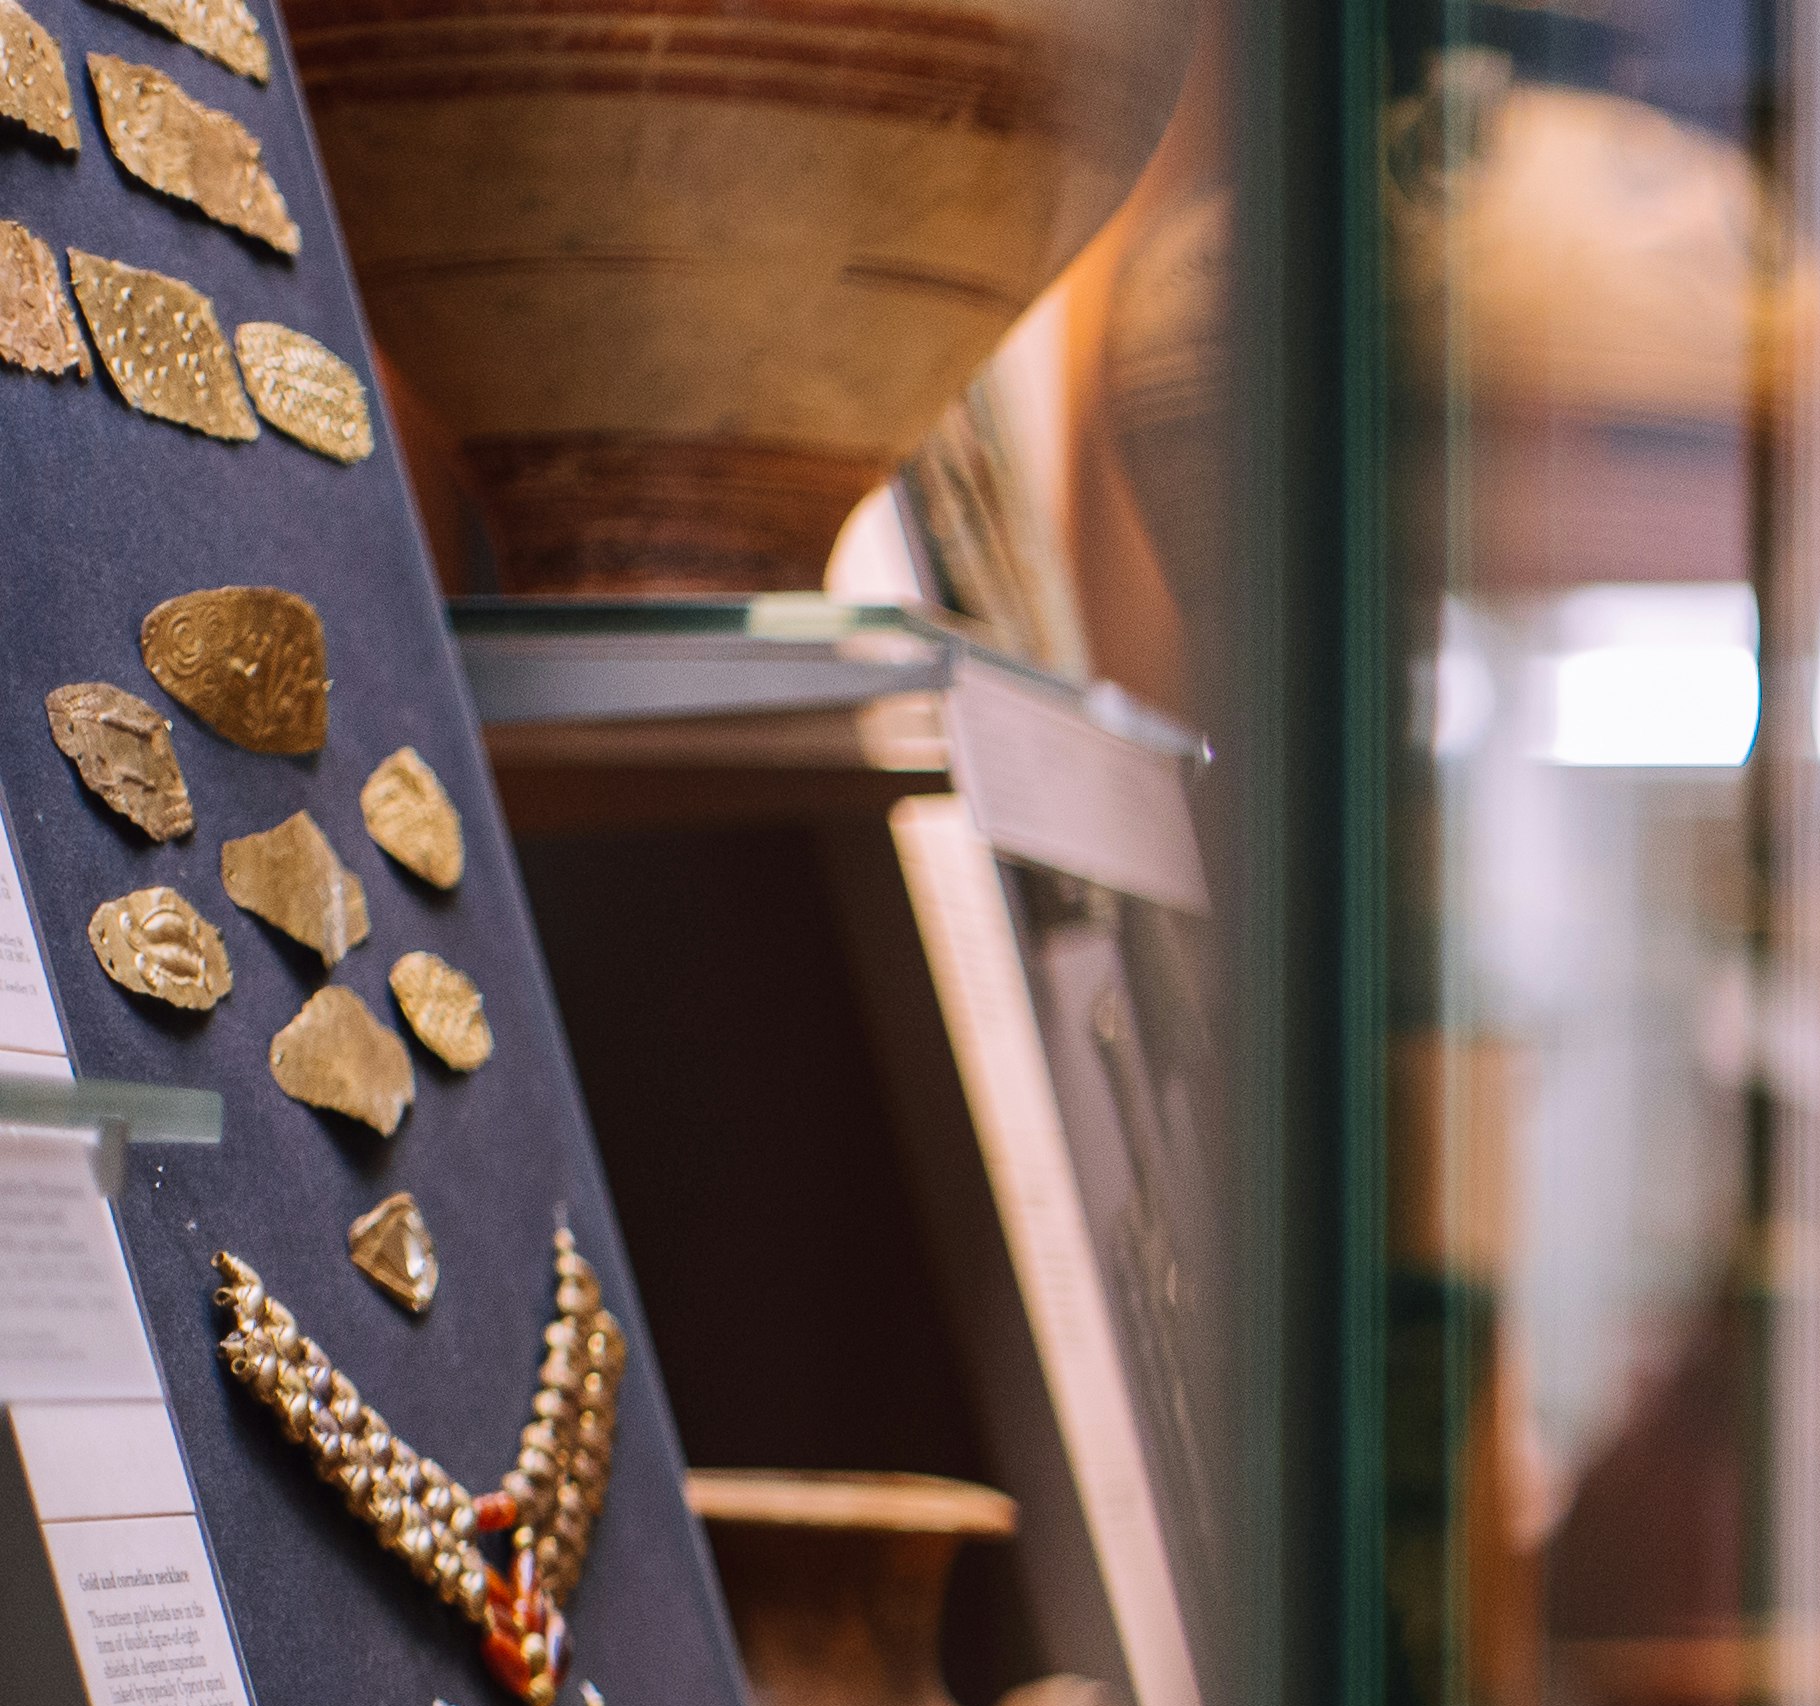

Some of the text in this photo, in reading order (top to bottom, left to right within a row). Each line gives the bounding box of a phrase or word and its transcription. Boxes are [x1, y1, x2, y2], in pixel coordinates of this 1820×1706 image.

[78, 1566, 189, 1590] Gold and cornelian necklace
[87, 1609, 105, 1628] The
[132, 1605, 150, 1628] gold
[148, 1604, 171, 1622] beads
[171, 1608, 183, 1620] are
[183, 1606, 193, 1619] in
[191, 1600, 205, 1618] the
[114, 1632, 124, 1651] of
[129, 1656, 139, 1675] of
[132, 1683, 145, 1704] by
[176, 1676, 205, 1698] Cypriot
